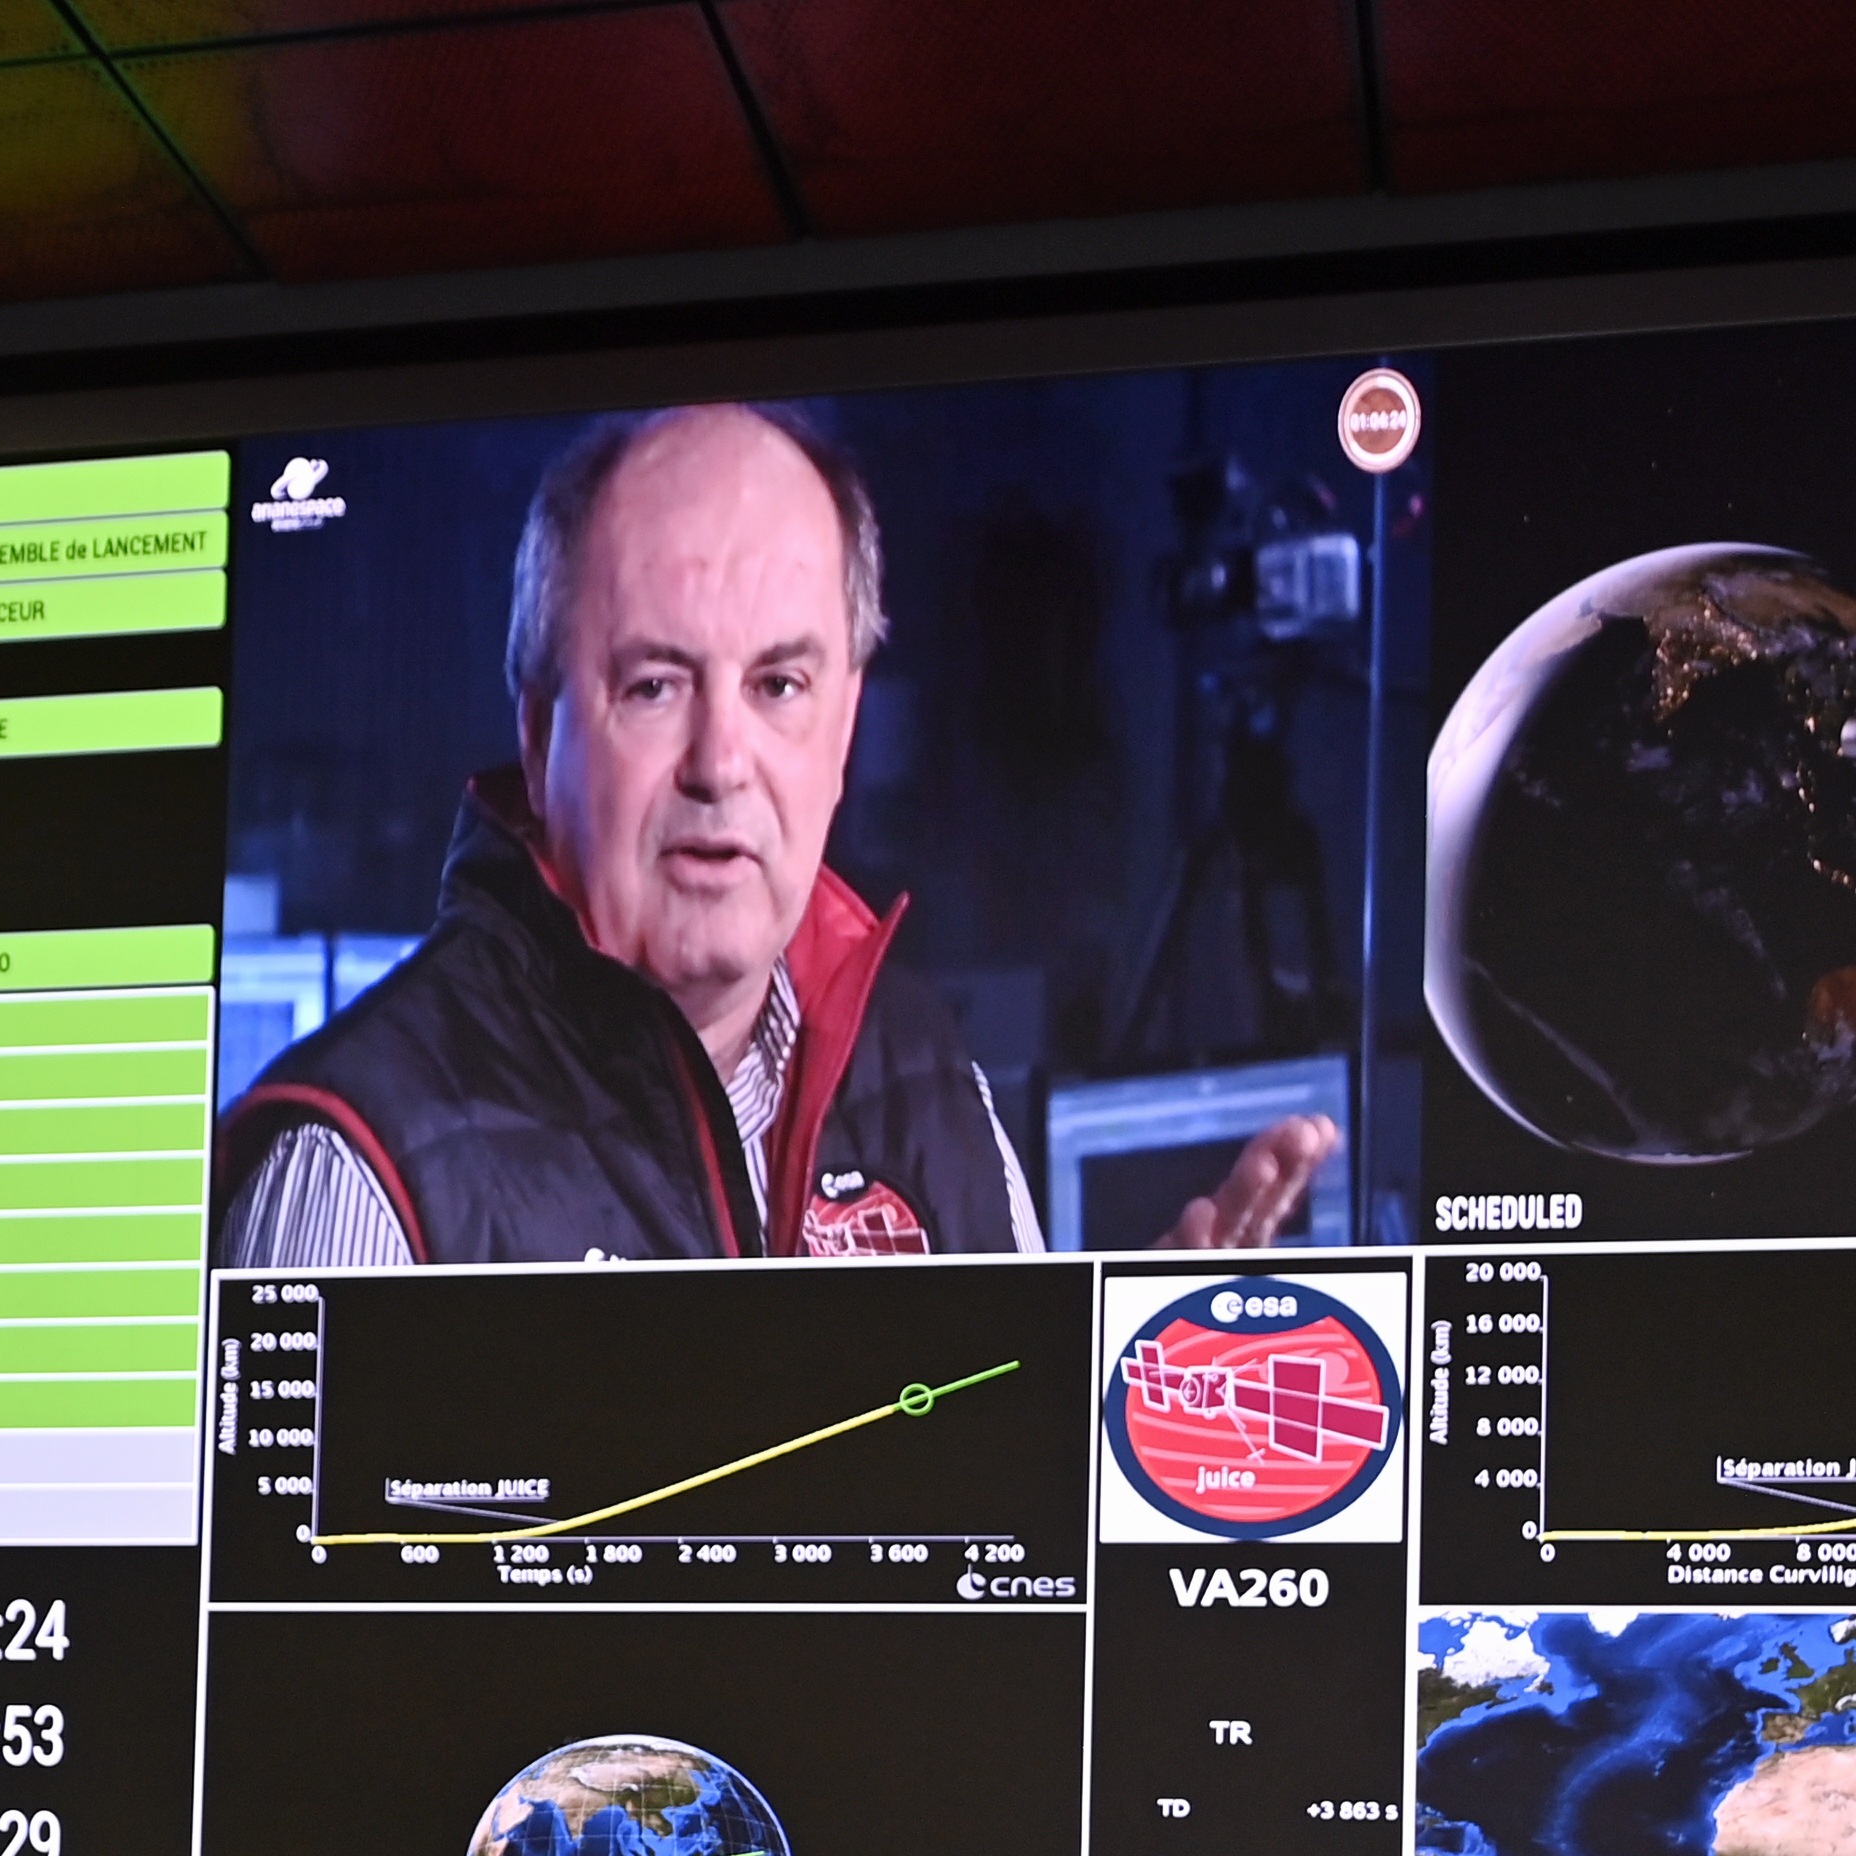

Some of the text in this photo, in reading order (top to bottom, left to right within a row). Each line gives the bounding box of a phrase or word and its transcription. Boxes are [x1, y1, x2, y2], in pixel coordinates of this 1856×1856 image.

[65, 539, 87, 561] de
[92, 531, 207, 558] LANCEMENT
[1435, 1194, 1582, 1230] SCHEDULED
[1430, 1320, 1451, 1445] Altitude (km)
[218, 1338, 241, 1455] Altitude (km)
[1724, 1458, 1840, 1480] Séparation
[390, 1478, 549, 1499] Séparation JUICE
[1197, 1466, 1255, 1494] juice
[401, 1546, 439, 1563] 600
[494, 1546, 549, 1563] 1 200
[586, 1546, 642, 1563] 1 800
[774, 1545, 832, 1563] 3 000
[870, 1545, 928, 1563] 3 600
[965, 1545, 1024, 1563] 4 200
[1667, 1544, 1731, 1561] 4 000
[498, 1565, 593, 1585] Temps (s)
[1667, 1564, 1763, 1584] Distance
[990, 1573, 1076, 1599] cnes
[1170, 1569, 1329, 1607] VA260
[1210, 1720, 1253, 1744] TR
[1157, 1799, 1191, 1817] TD
[1339, 1802, 1380, 1819] 863
[1385, 1804, 1398, 1819] s
